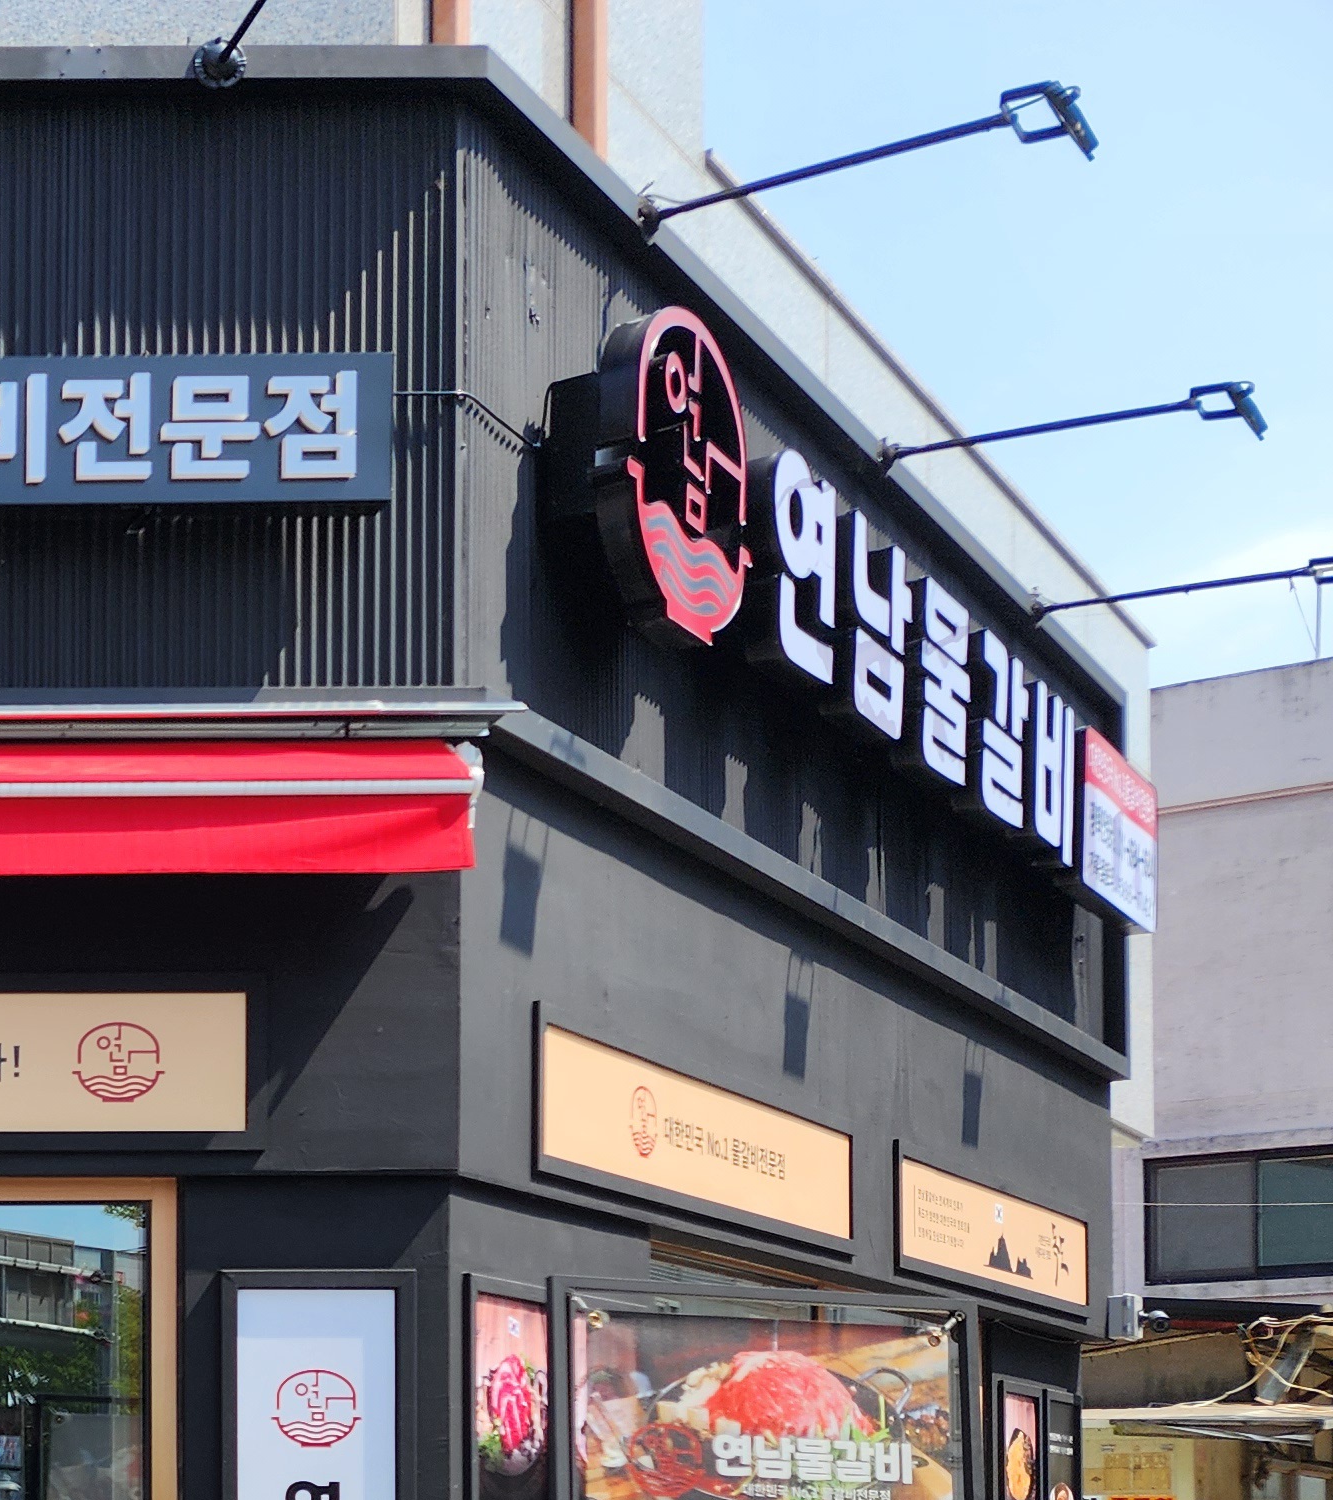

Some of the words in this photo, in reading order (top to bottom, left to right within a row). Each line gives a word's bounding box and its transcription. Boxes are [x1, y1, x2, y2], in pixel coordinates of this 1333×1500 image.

[774, 448, 1075, 868] 연남물갈비
[663, 1115, 704, 1156] 대한민국
[706, 1135, 730, 1165] No.1
[731, 1138, 787, 1182] 물갈비전문점
[713, 1433, 913, 1485] 연남물갈비
